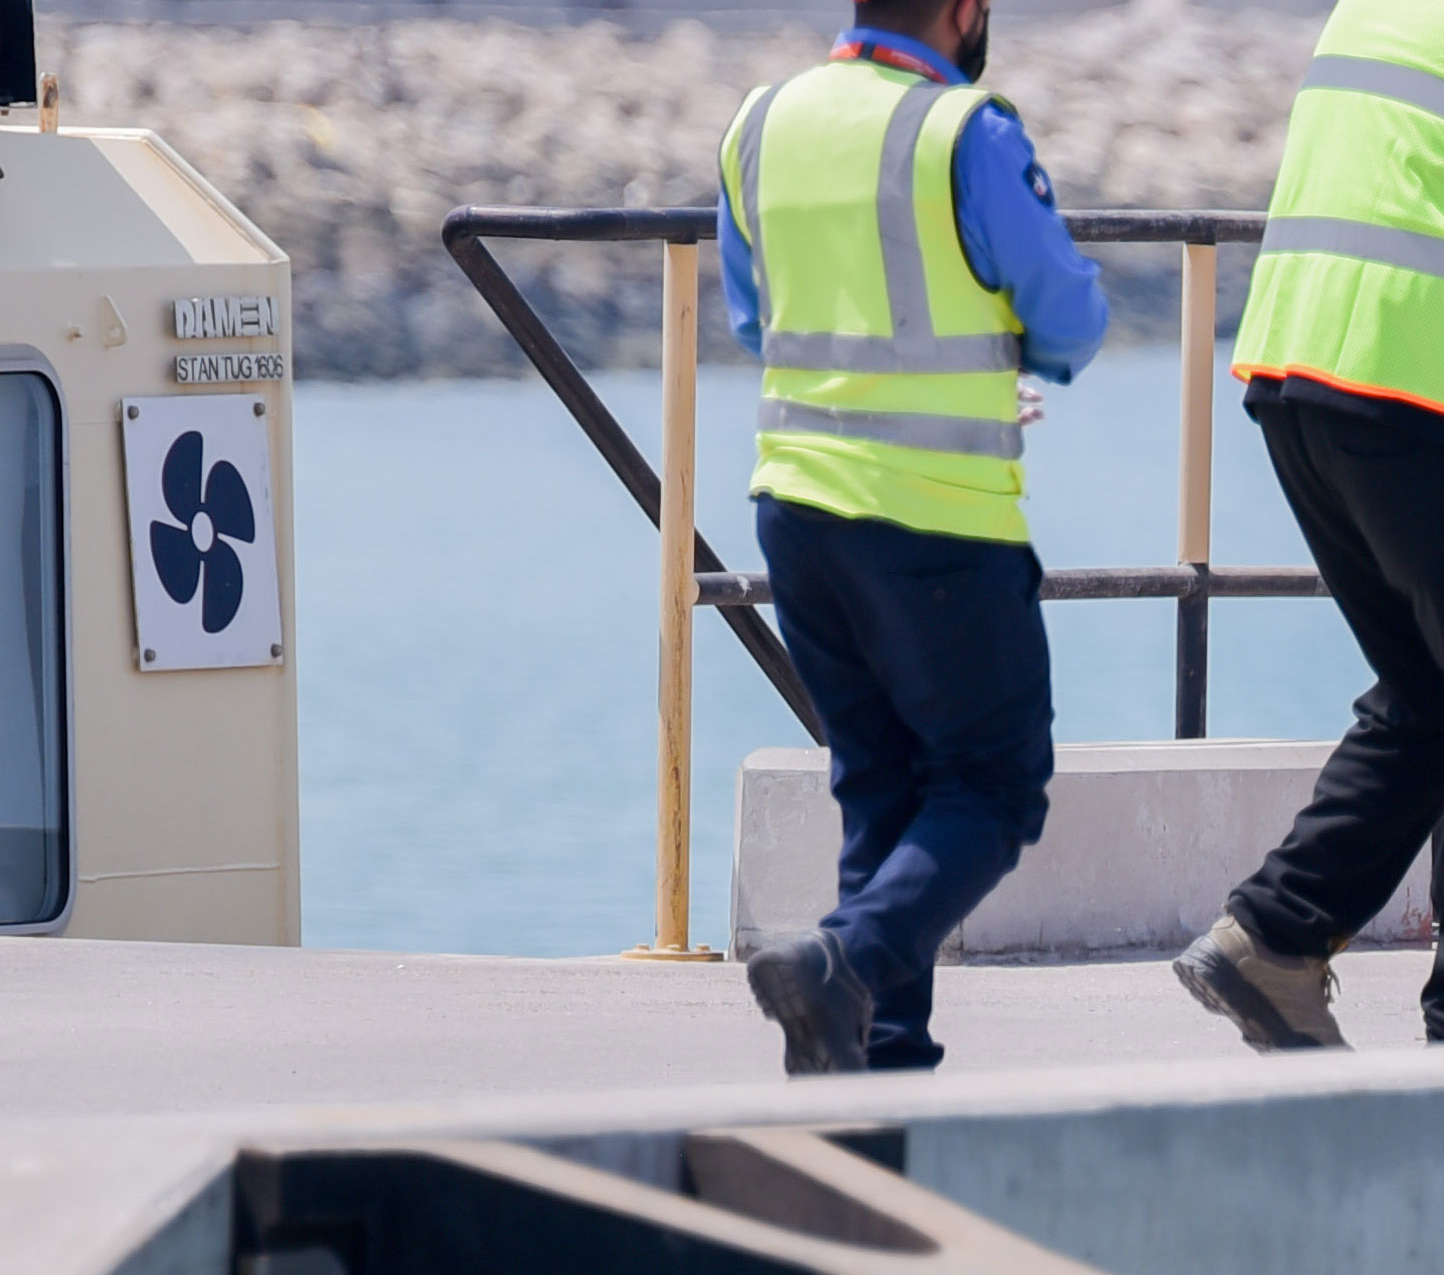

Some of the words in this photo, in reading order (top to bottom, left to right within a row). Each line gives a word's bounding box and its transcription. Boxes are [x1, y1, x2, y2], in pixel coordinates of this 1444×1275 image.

[173, 296, 280, 339] DAMEN
[177, 356, 219, 382] STAN
[220, 355, 252, 380] TUG
